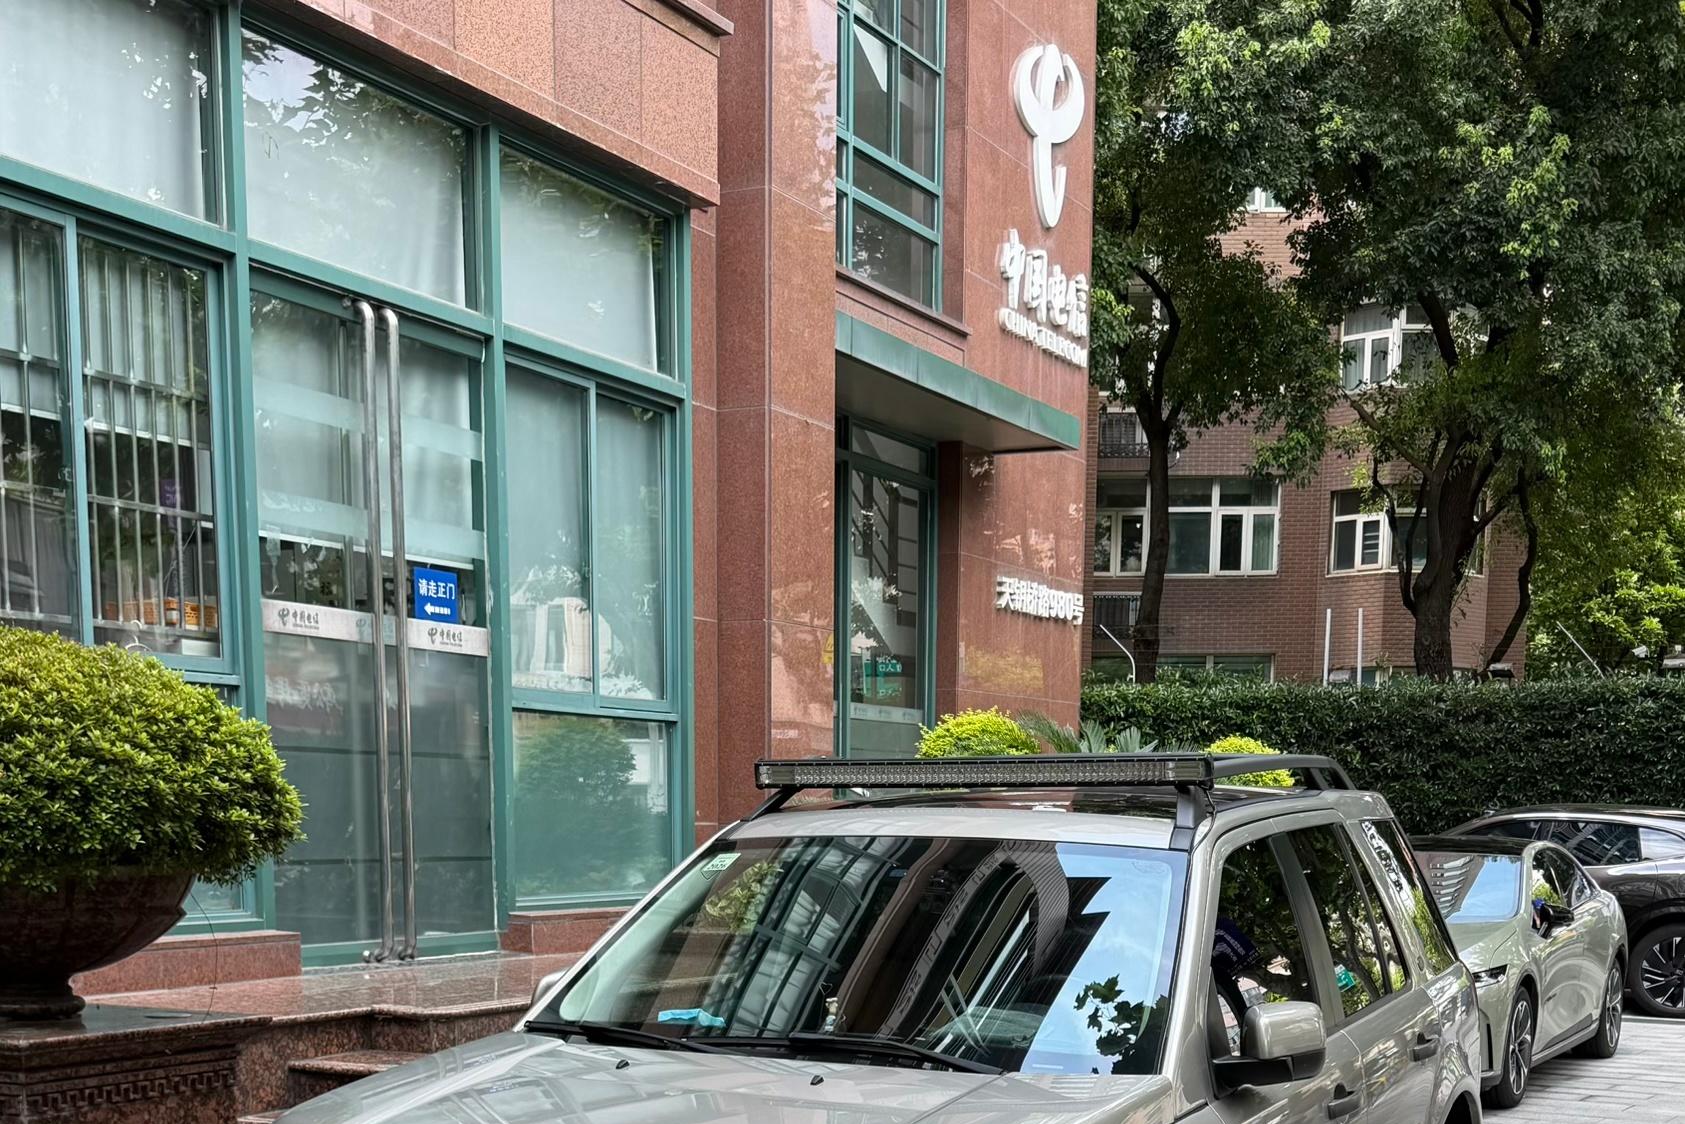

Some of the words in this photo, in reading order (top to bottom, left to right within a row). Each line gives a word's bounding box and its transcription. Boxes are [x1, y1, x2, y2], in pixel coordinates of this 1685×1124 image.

[1000, 228, 1088, 337] 中国电信
[998, 307, 1038, 346] CHINA
[418, 578, 455, 600] 请走正门
